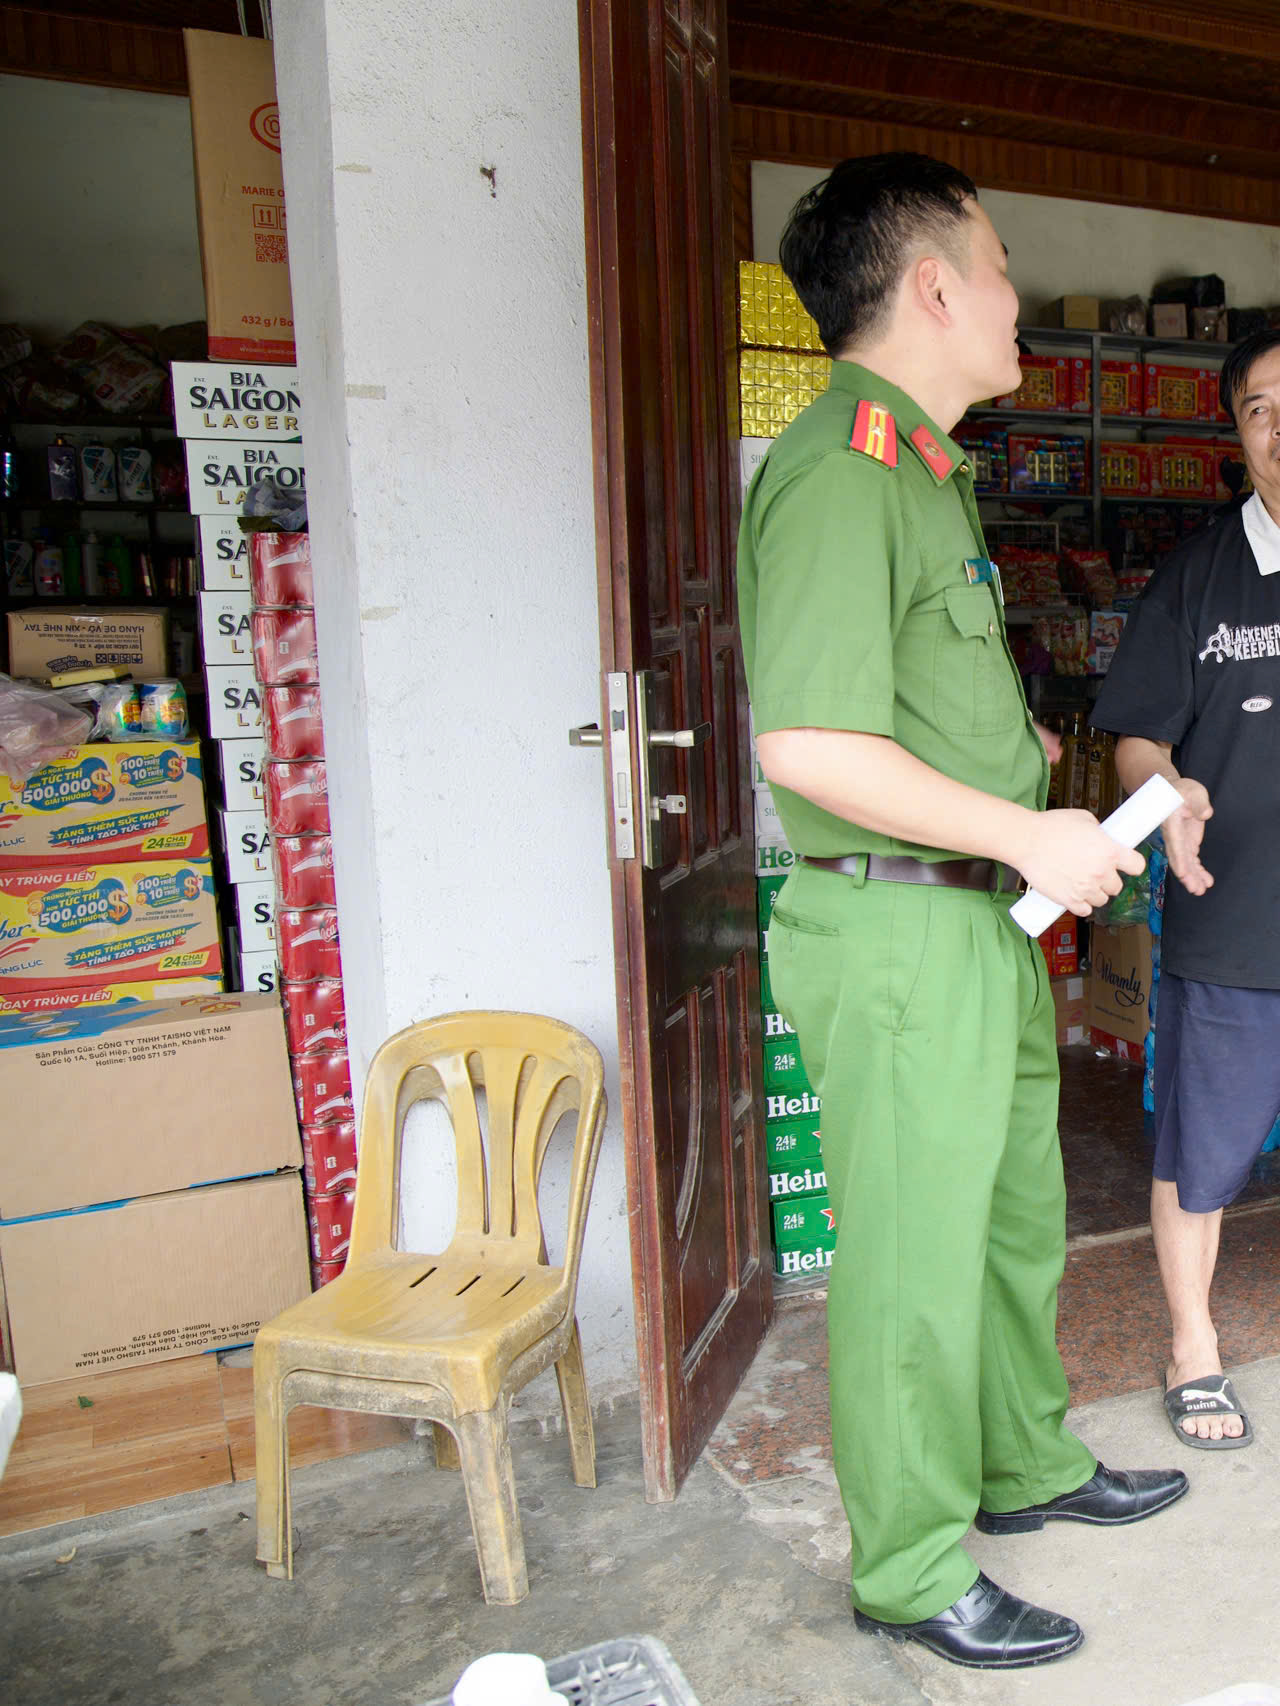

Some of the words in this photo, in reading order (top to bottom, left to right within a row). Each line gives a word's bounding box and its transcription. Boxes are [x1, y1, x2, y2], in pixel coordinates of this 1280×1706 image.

[241, 186, 275, 196] MARIE
[241, 315, 262, 325] 432
[264, 318, 271, 328] g
[230, 372, 268, 387] BIA
[189, 386, 301, 413] SAIGON
[203, 413, 299, 431] LAGER
[243, 450, 280, 464] BIA
[24, 624, 41, 632] TAY
[122, 758, 144, 770] 100
[133, 768, 147, 780] 10
[23, 778, 91, 803] 500.000
[146, 838, 164, 849] 24
[166, 836, 188, 844] CHAI
[758, 846, 795, 869] He
[138, 878, 160, 890] 100
[149, 888, 164, 900] 10
[40, 899, 108, 926] 500.000
[162, 956, 180, 968] 24
[98, 1040, 122, 1050] CÔNG
[137, 1036, 160, 1044] TNHH
[162, 1032, 192, 1040] TAISHO
[213, 1026, 232, 1034] NAM
[96, 1058, 126, 1067] Hotline:
[128, 1054, 146, 1062] 1900
[148, 1052, 161, 1060] 571
[774, 1054, 788, 1066] 24
[776, 1136, 790, 1146] 24
[784, 1213, 798, 1226] 24
[162, 1328, 180, 1336] 1900
[148, 1345, 170, 1354] TNHH
[172, 1342, 184, 1350] TY
[116, 1350, 146, 1359] TAISHO
[75, 1360, 94, 1368] NAM
[1186, 1400, 1218, 1412] PUMA
